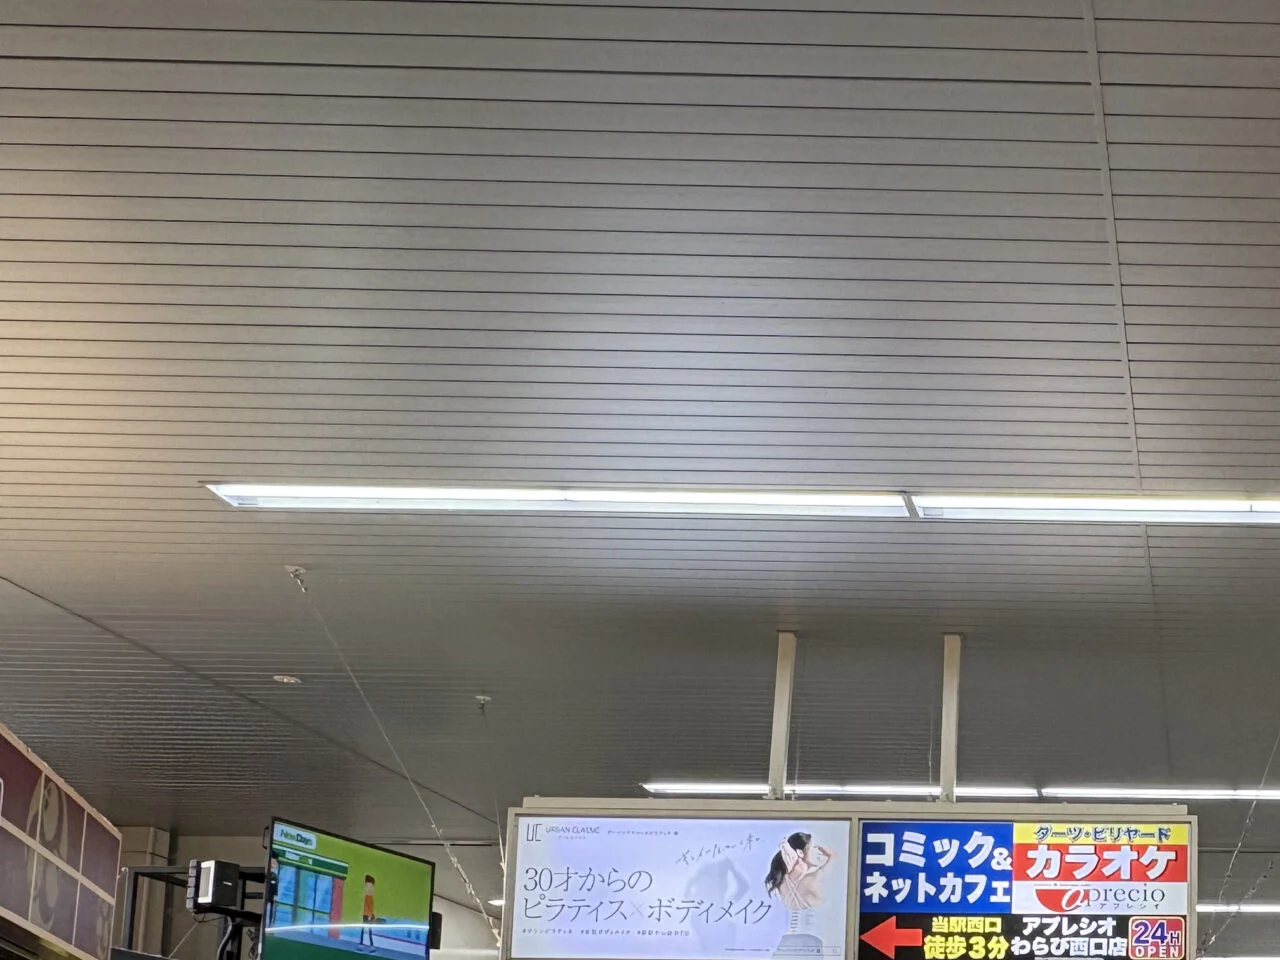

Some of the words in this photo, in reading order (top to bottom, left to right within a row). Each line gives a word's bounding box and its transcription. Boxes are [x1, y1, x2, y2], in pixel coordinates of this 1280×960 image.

[1035, 825, 1171, 843] ダーツ・ビリヤード
[1026, 845, 1177, 879] カラオケ
[524, 867, 653, 892] 30才からの
[864, 871, 1011, 903] ネットカフェ
[1061, 882, 1166, 911] aprecio
[932, 917, 1002, 934] 当駅西口
[1022, 916, 1117, 936] アプレシオ
[1131, 920, 1182, 946] 24H
[923, 936, 1010, 960] 徒歩3分
[1011, 936, 1128, 957] わらび西口店
[1135, 946, 1179, 958] OPEN
